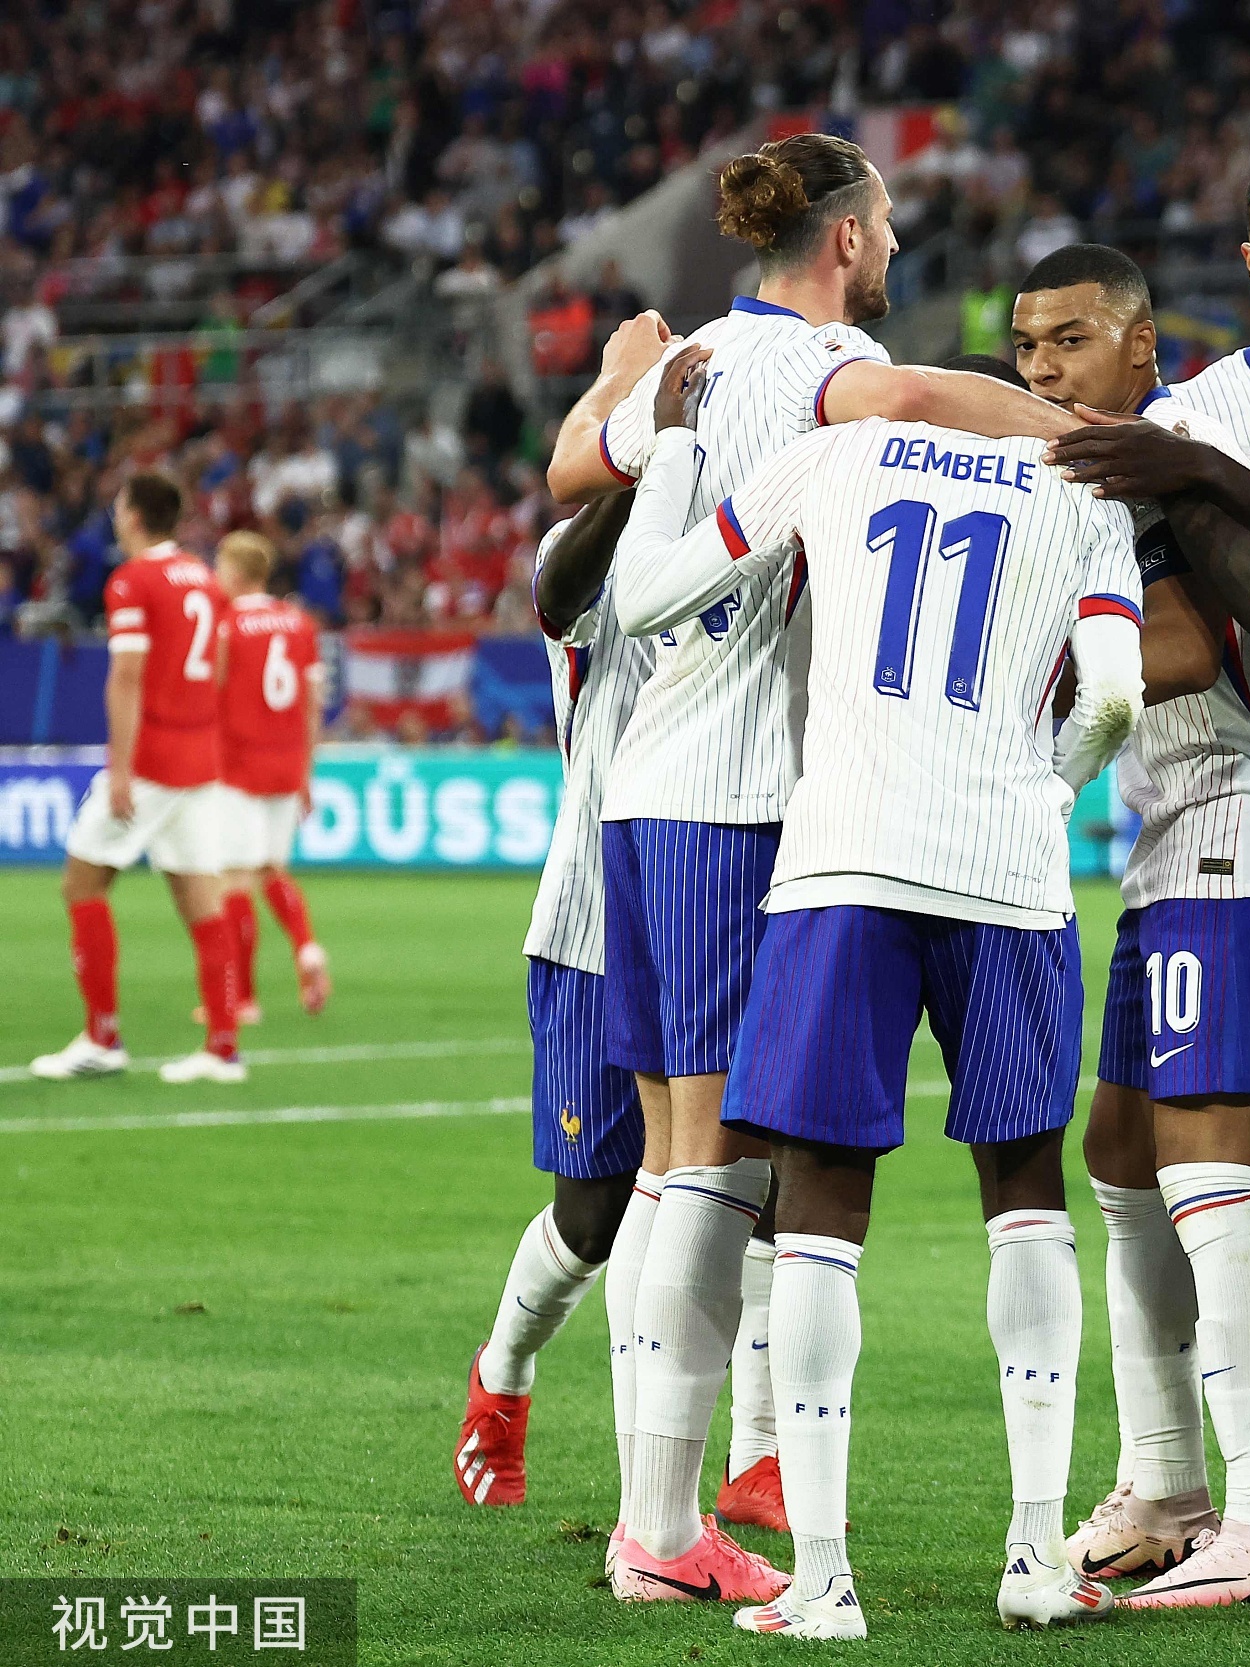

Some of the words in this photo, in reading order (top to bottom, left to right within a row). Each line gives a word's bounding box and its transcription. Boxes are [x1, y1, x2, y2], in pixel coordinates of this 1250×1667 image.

[879, 437, 1036, 494] DEMBELE
[1139, 548, 1167, 573] PECT
[182, 588, 214, 683] 2
[866, 498, 1012, 713] 11
[261, 633, 299, 713] 6
[300, 757, 567, 864] DÜSS
[1145, 950, 1203, 1036] 10
